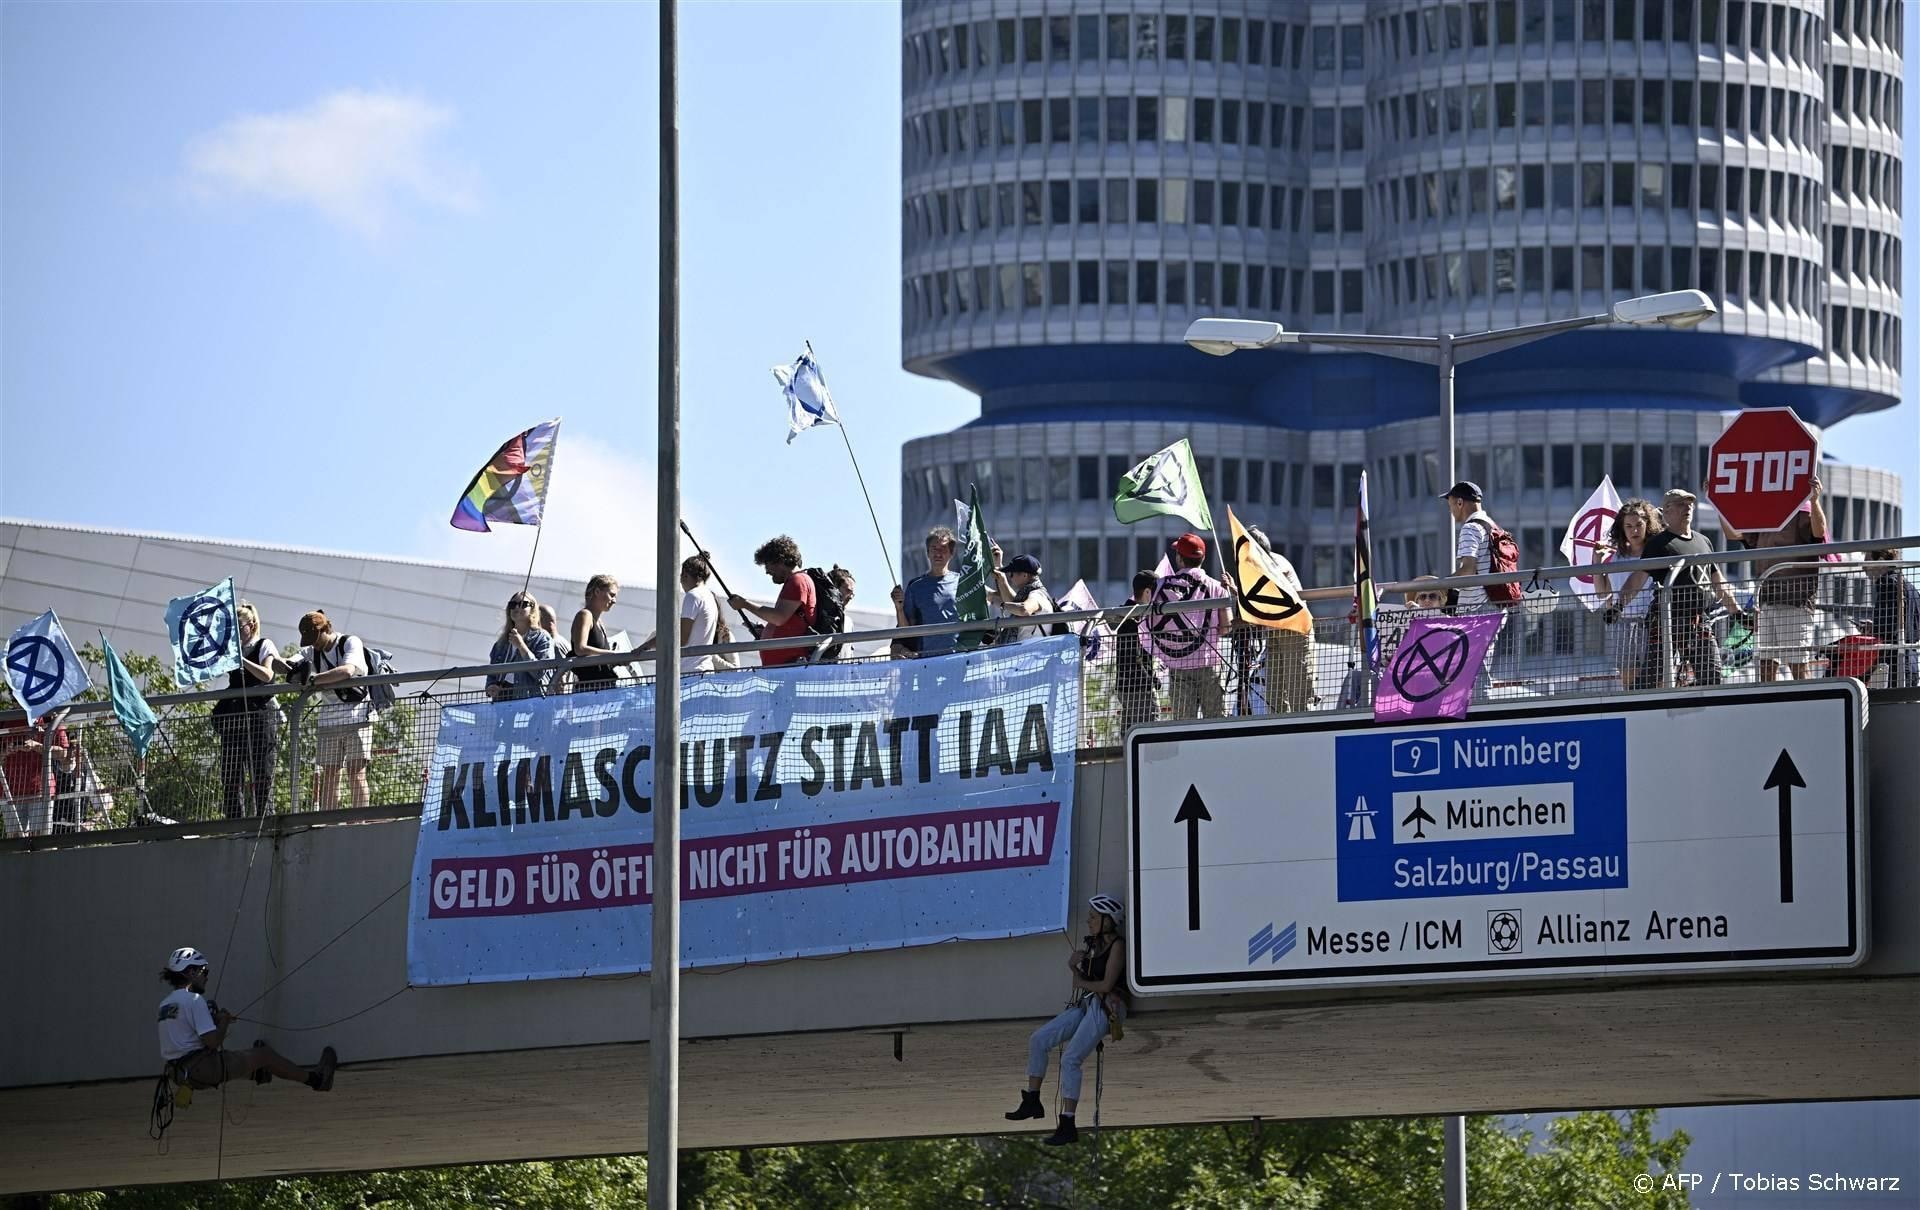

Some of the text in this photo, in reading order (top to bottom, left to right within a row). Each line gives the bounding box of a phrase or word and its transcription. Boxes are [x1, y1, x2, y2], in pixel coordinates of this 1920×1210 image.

[1714, 449, 1810, 494] STOP
[438, 703, 1054, 831] KLIMASCUTZ STATT IAA
[1410, 736, 1582, 772] 9 Nürnberg
[1446, 796, 1567, 830] München
[433, 815, 1045, 910] GELD FÜR ÖFFI NICHT FÜR AUTOBAHNEN
[1393, 851, 1620, 891] Salzburg/Passau
[1306, 925, 1390, 955] Messe
[1537, 911, 1729, 945] Allianz Arena
